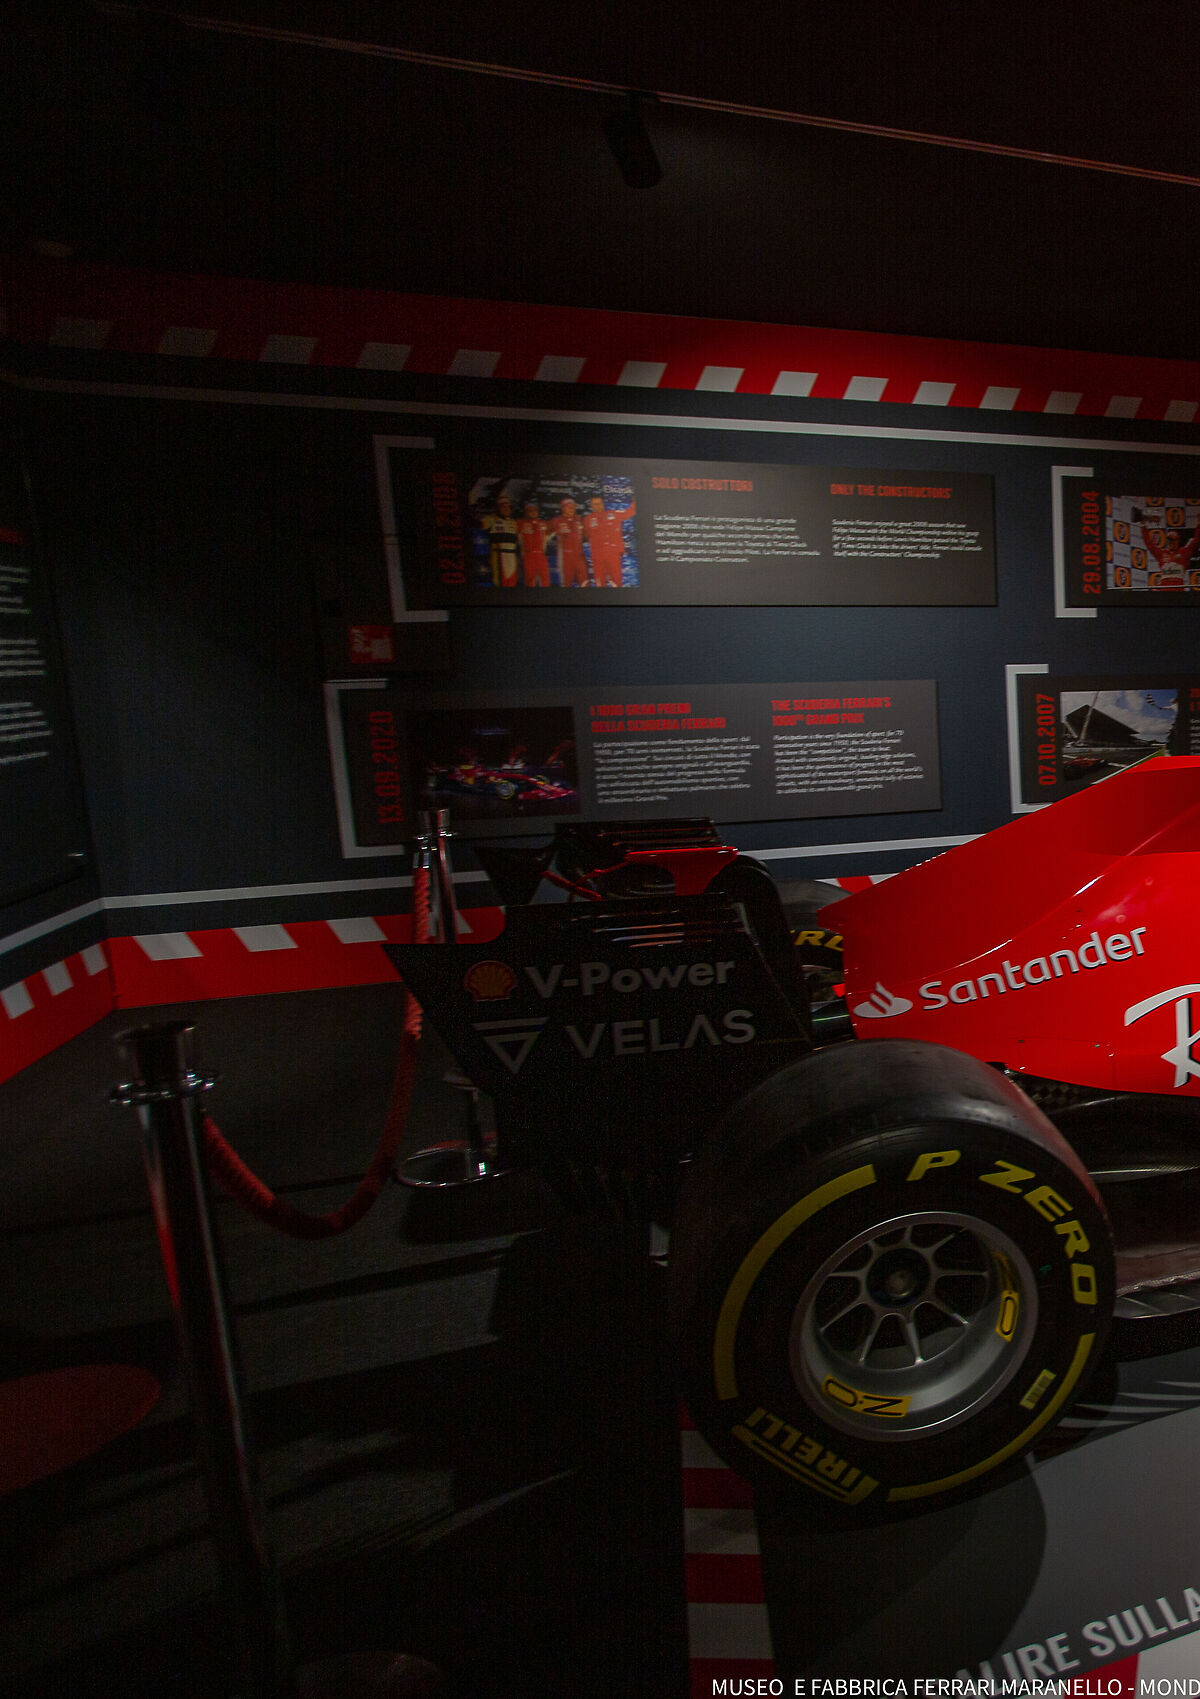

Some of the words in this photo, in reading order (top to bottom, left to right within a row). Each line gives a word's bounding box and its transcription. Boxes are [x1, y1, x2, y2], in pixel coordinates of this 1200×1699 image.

[1081, 491, 1101, 594] 29.08.2004
[1036, 693, 1057, 785] 07.10.2007
[524, 960, 736, 999] V-Power
[918, 926, 1147, 1012] Santander
[564, 1008, 757, 1059] VELAS
[906, 1150, 961, 1182] P
[978, 1160, 1098, 1306] ZERO
[731, 1407, 880, 1505] PIRELLI
